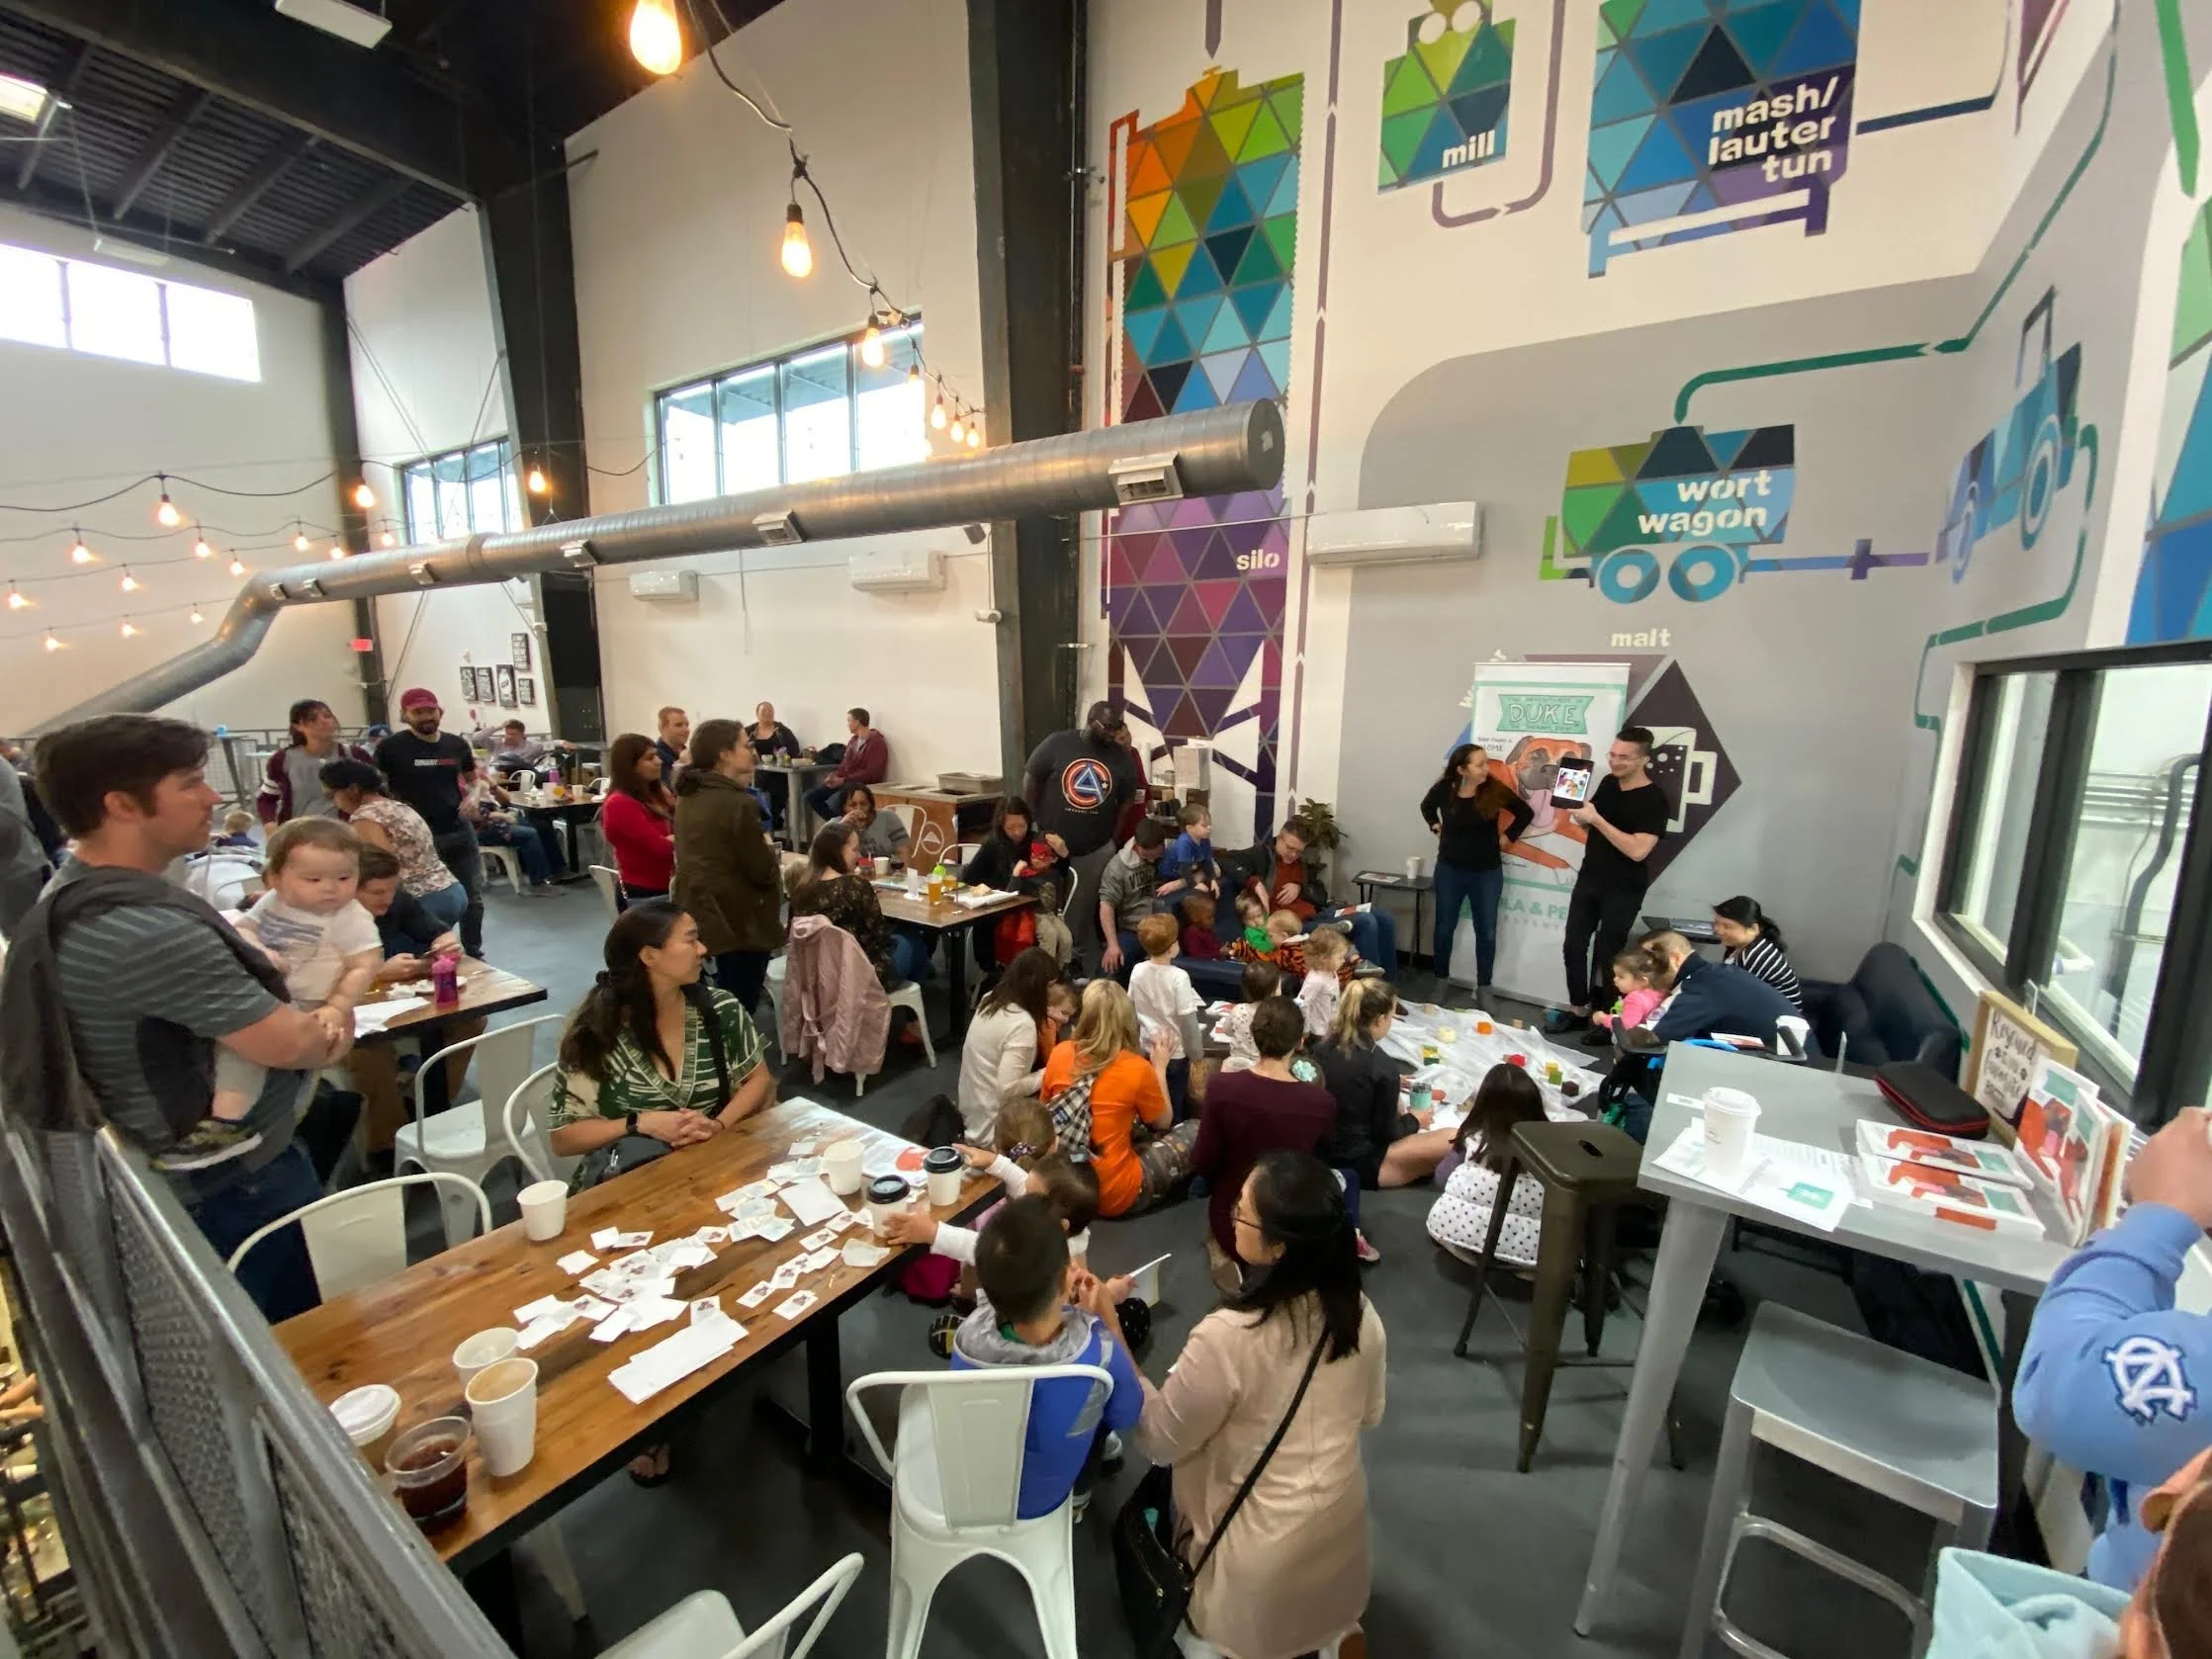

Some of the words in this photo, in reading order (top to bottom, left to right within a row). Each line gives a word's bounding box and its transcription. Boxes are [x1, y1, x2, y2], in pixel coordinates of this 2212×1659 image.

[1711, 75, 1838, 132] mash/
[1441, 130, 1495, 169] mill
[1707, 112, 1837, 168] lauter
[1761, 147, 1832, 184] tun
[1677, 469, 1772, 502] wort
[1637, 505, 1768, 538] wagon
[1235, 550, 1281, 570] silo
[1611, 628, 1672, 649] malt
[1529, 901, 1543, 917] &
